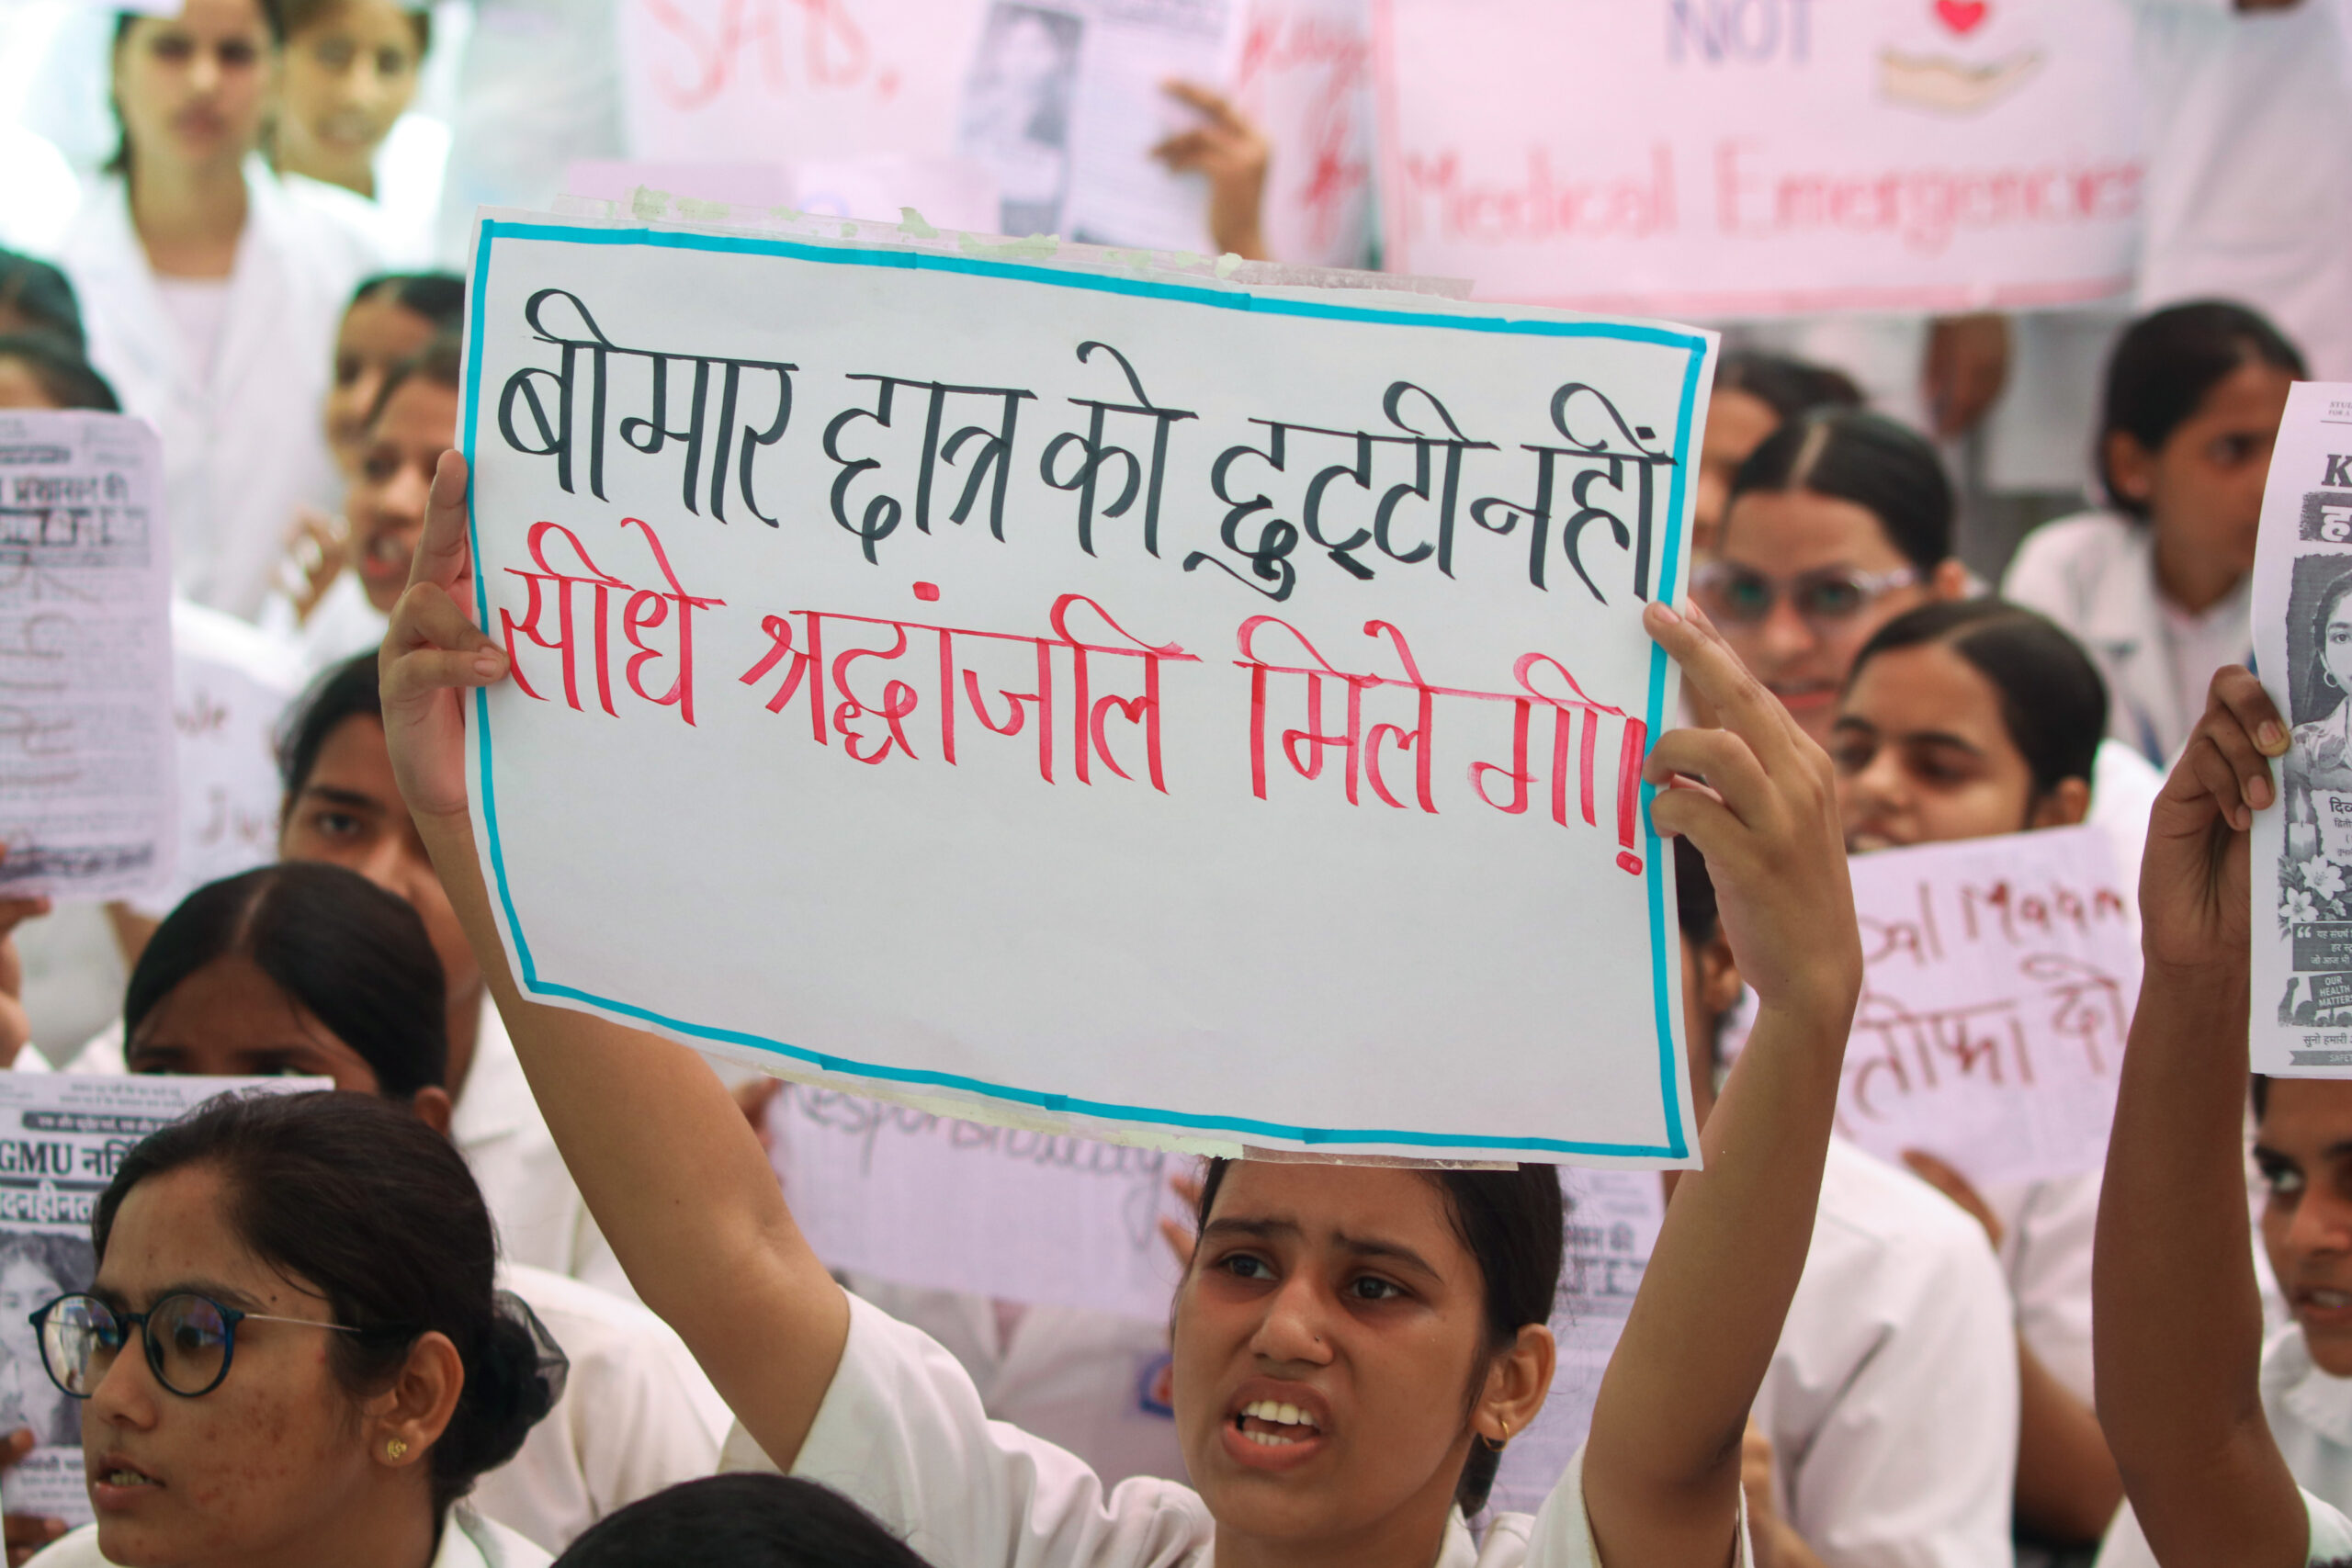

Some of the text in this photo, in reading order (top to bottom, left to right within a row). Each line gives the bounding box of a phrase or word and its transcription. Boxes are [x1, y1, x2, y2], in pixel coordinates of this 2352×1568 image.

[1402, 134, 2150, 257] Medical Emergencies
[498, 288, 1679, 606] बीमार छात्र को छुट्टी नहीं
[499, 516, 727, 728] सीधे
[738, 581, 1203, 795] श्रद्धांजलि
[2319, 985, 2350, 998] HEALTH
[2324, 976, 2344, 987] OUR
[2302, 1032, 2348, 1048] सुनो हमारी
[0, 1140, 73, 1176] GMU
